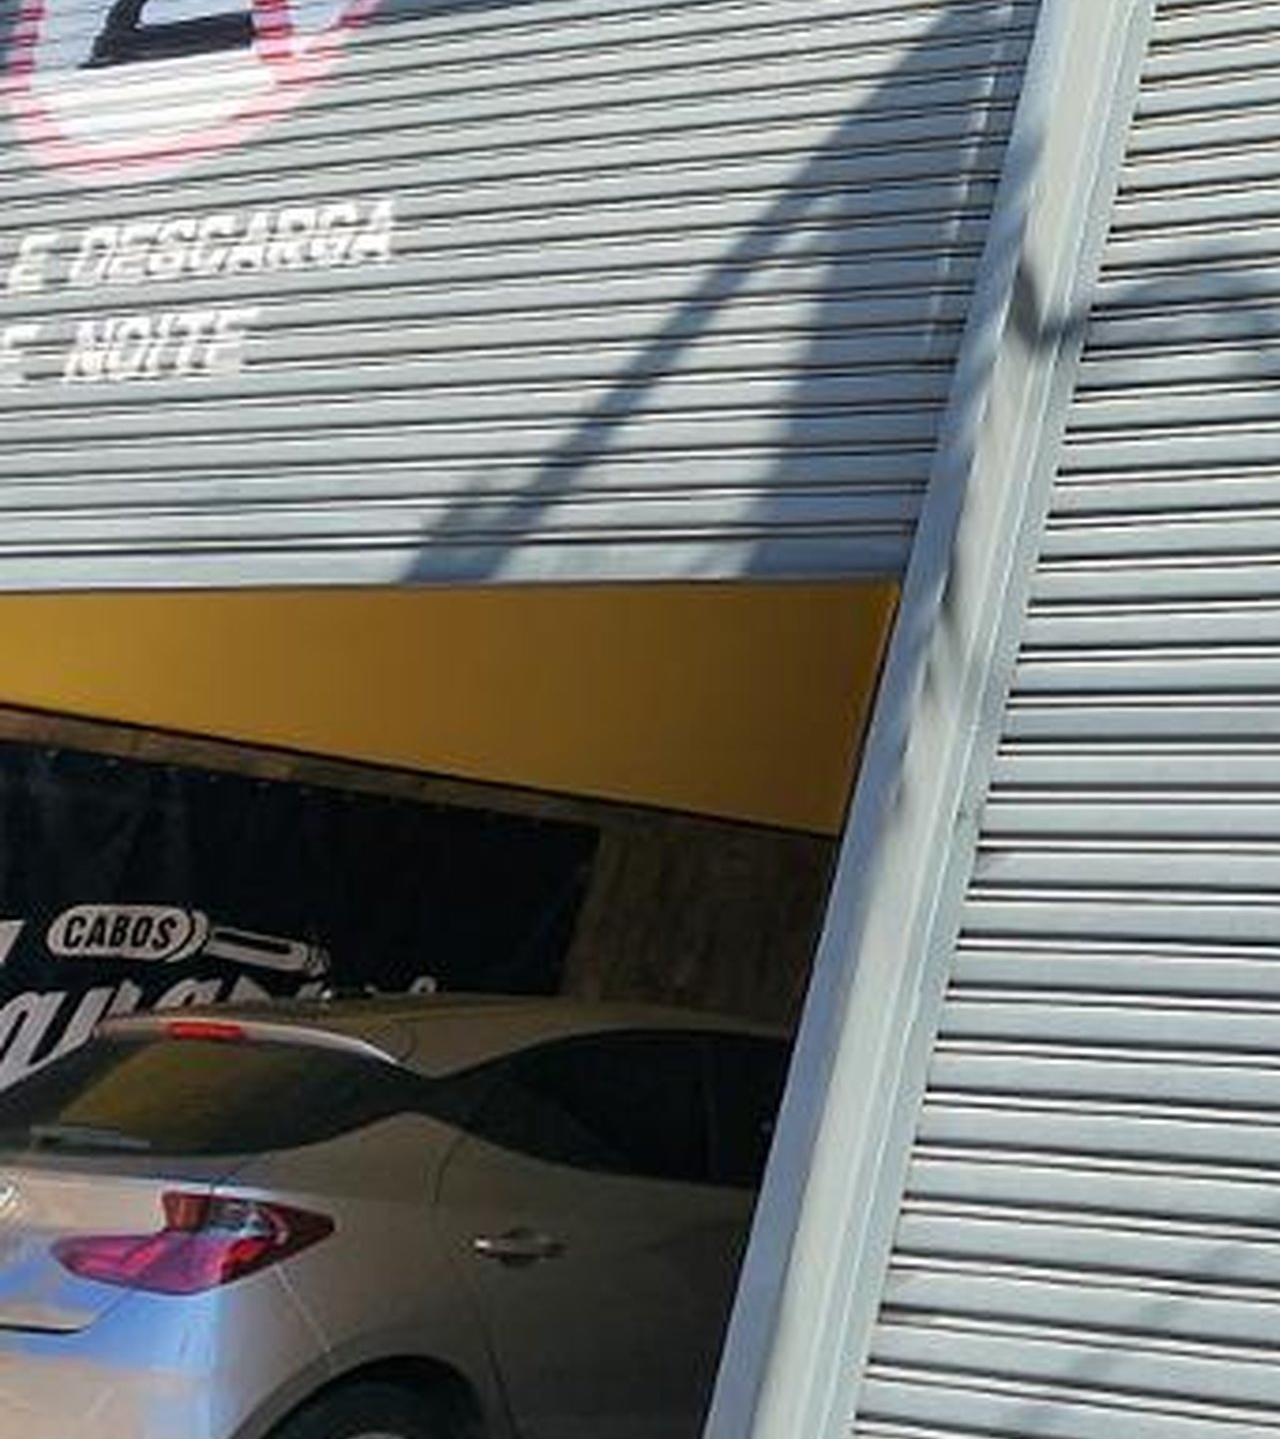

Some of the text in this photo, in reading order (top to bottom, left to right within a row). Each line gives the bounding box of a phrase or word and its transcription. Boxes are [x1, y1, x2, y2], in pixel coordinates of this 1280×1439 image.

[68, 201, 397, 284] DESCARGA
[62, 308, 262, 382] NOITE
[62, 914, 178, 950] CABOS
